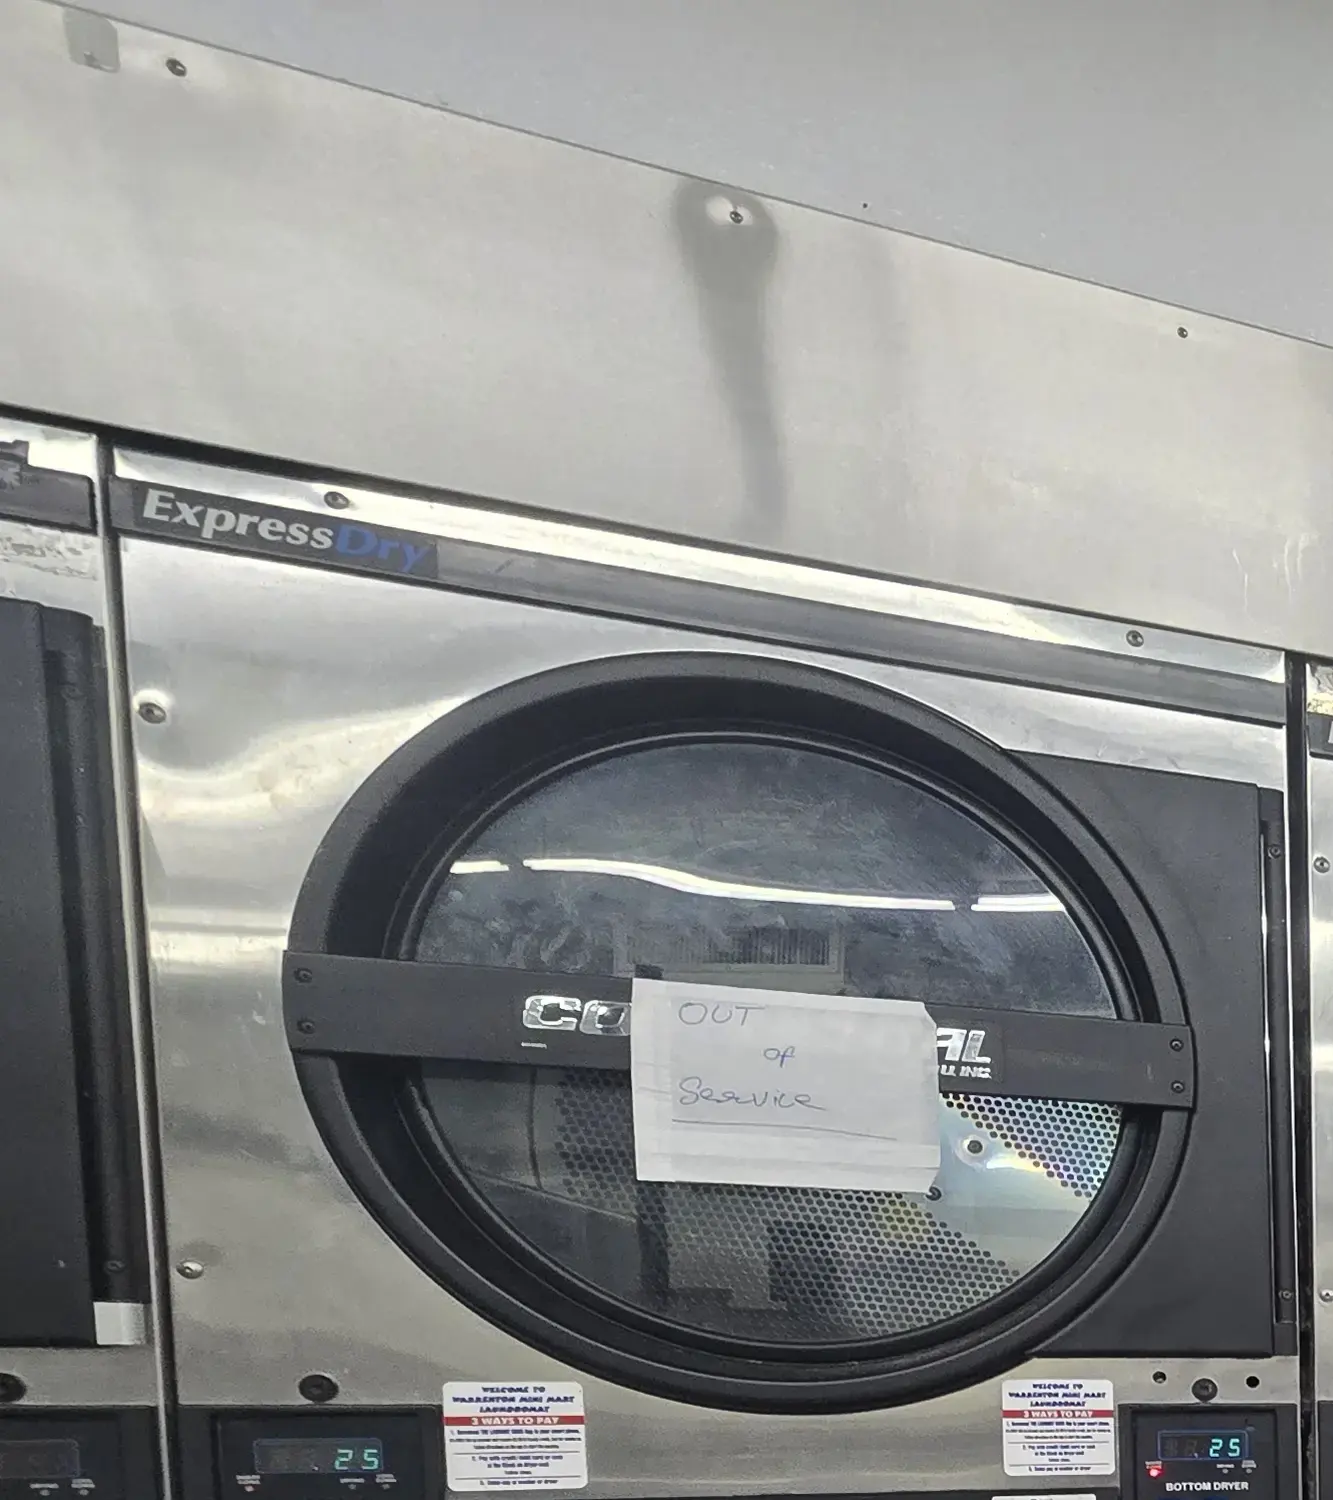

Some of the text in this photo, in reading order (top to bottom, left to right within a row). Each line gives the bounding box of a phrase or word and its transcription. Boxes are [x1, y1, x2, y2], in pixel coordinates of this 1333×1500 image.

[142, 490, 428, 572] ExpressDry
[678, 1002, 765, 1026] OUT
[763, 1045, 796, 1068] of
[536, 1417, 560, 1425] PAY
[1209, 1438, 1240, 1457] 25
[335, 1449, 379, 1470] 25
[1165, 1481, 1249, 1492] BOTTOM DRYER
